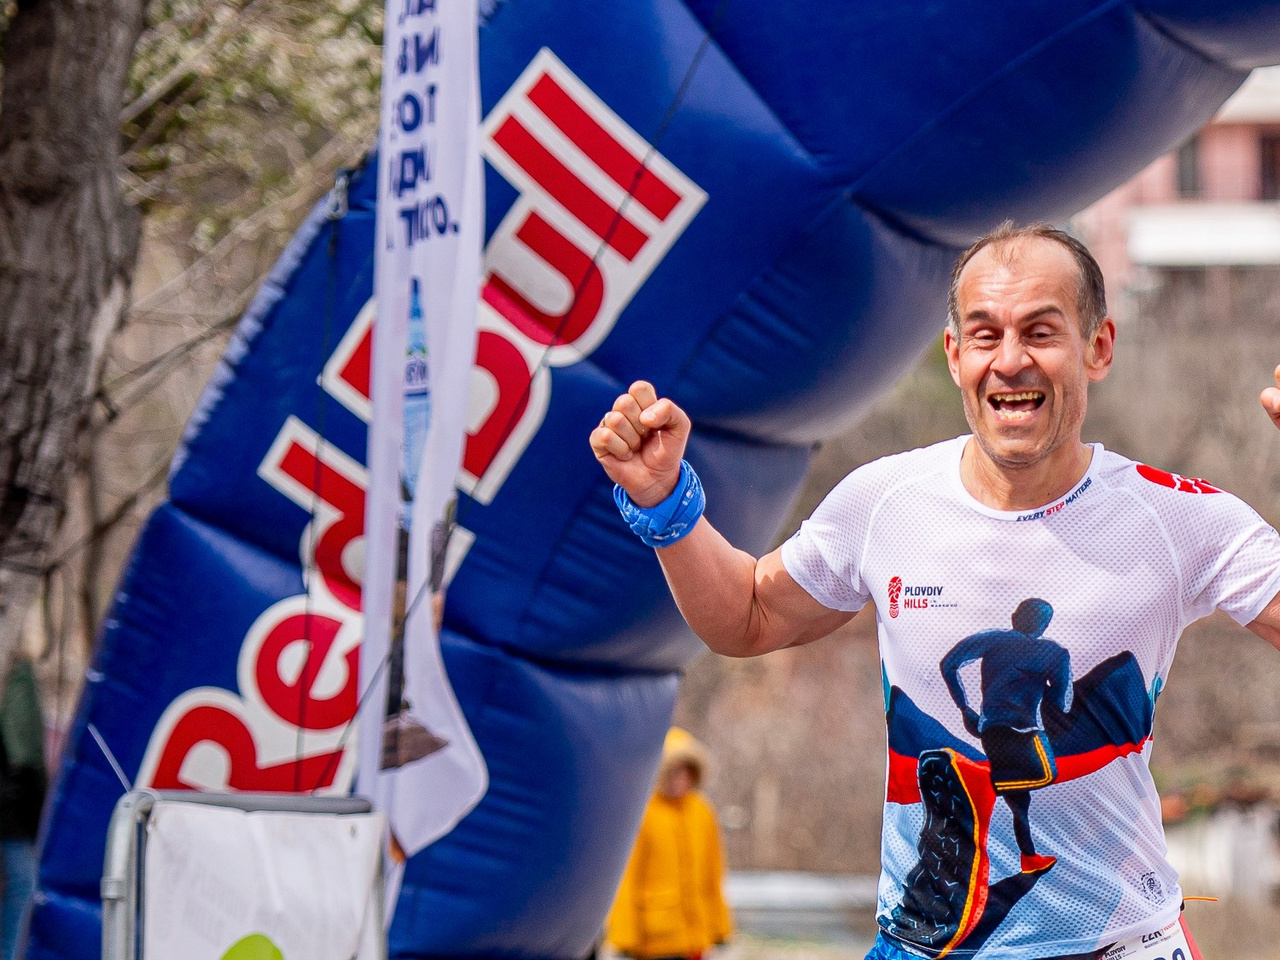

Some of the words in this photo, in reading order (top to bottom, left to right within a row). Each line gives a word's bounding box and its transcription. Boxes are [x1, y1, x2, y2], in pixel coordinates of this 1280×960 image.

[1016, 509, 1045, 522] EVERY
[1045, 501, 1065, 515] STEP
[1065, 476, 1092, 506] MATTERS
[904, 586, 943, 596] PLOVDIV
[904, 598, 928, 609] HILLS
[1104, 944, 1126, 959] PLOVDIV
